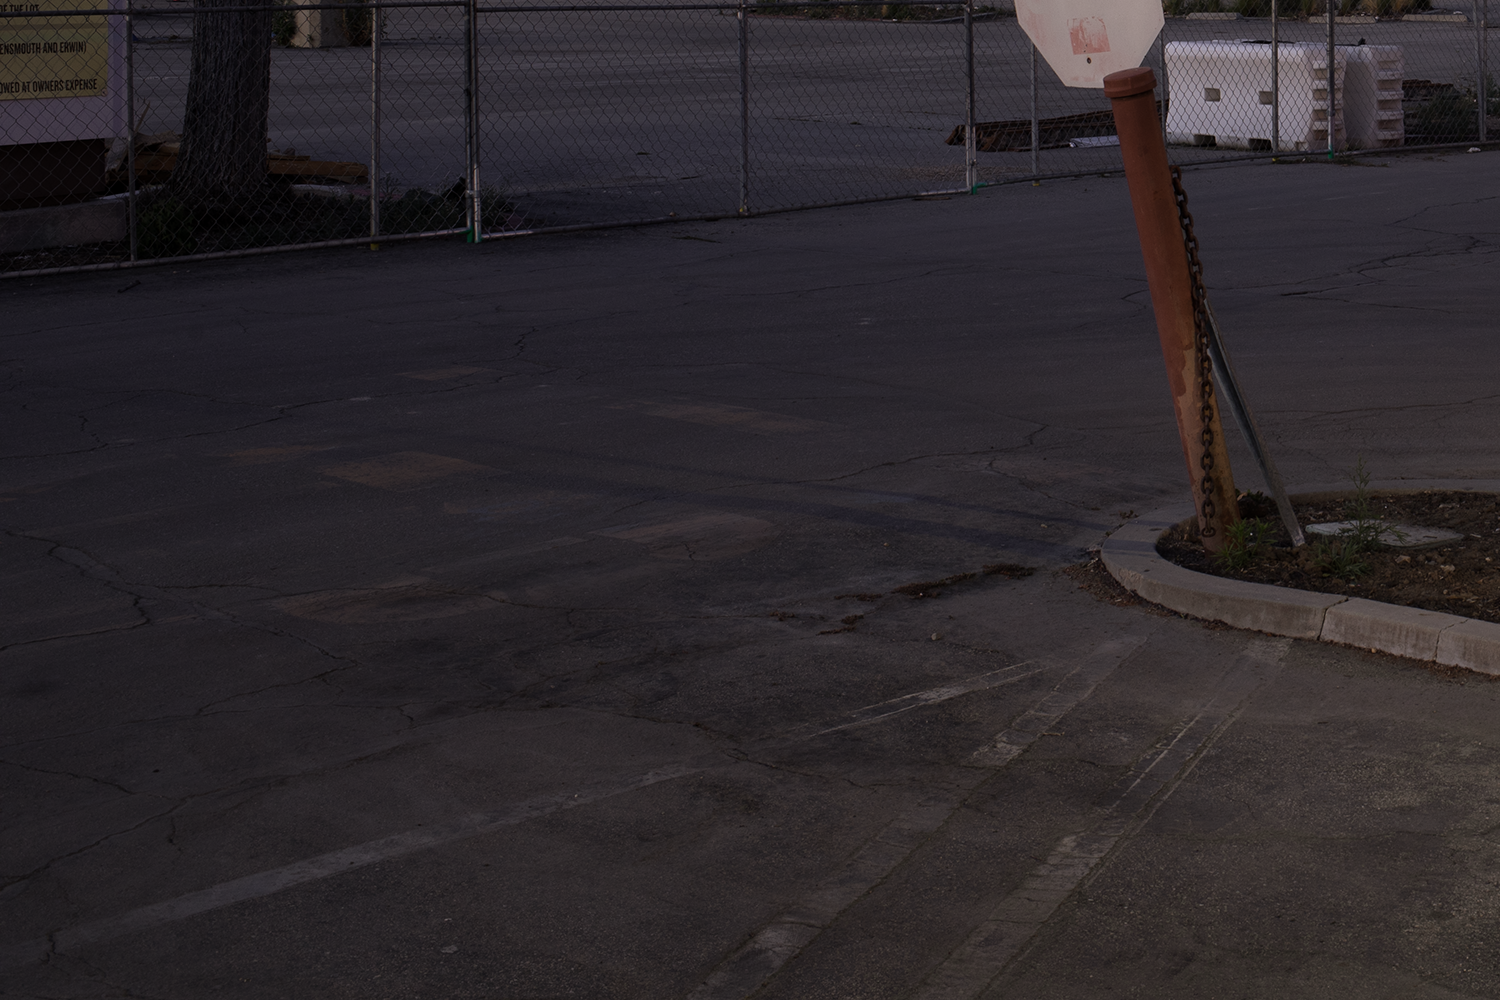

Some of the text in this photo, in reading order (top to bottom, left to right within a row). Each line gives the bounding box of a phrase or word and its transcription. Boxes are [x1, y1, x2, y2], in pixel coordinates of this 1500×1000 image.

[43, 42, 58, 54] AND
[60, 41, 87, 55] ERWIN)
[21, 81, 31, 93] AT
[32, 80, 64, 93] OWNERS
[65, 79, 98, 91] EXPENSE
